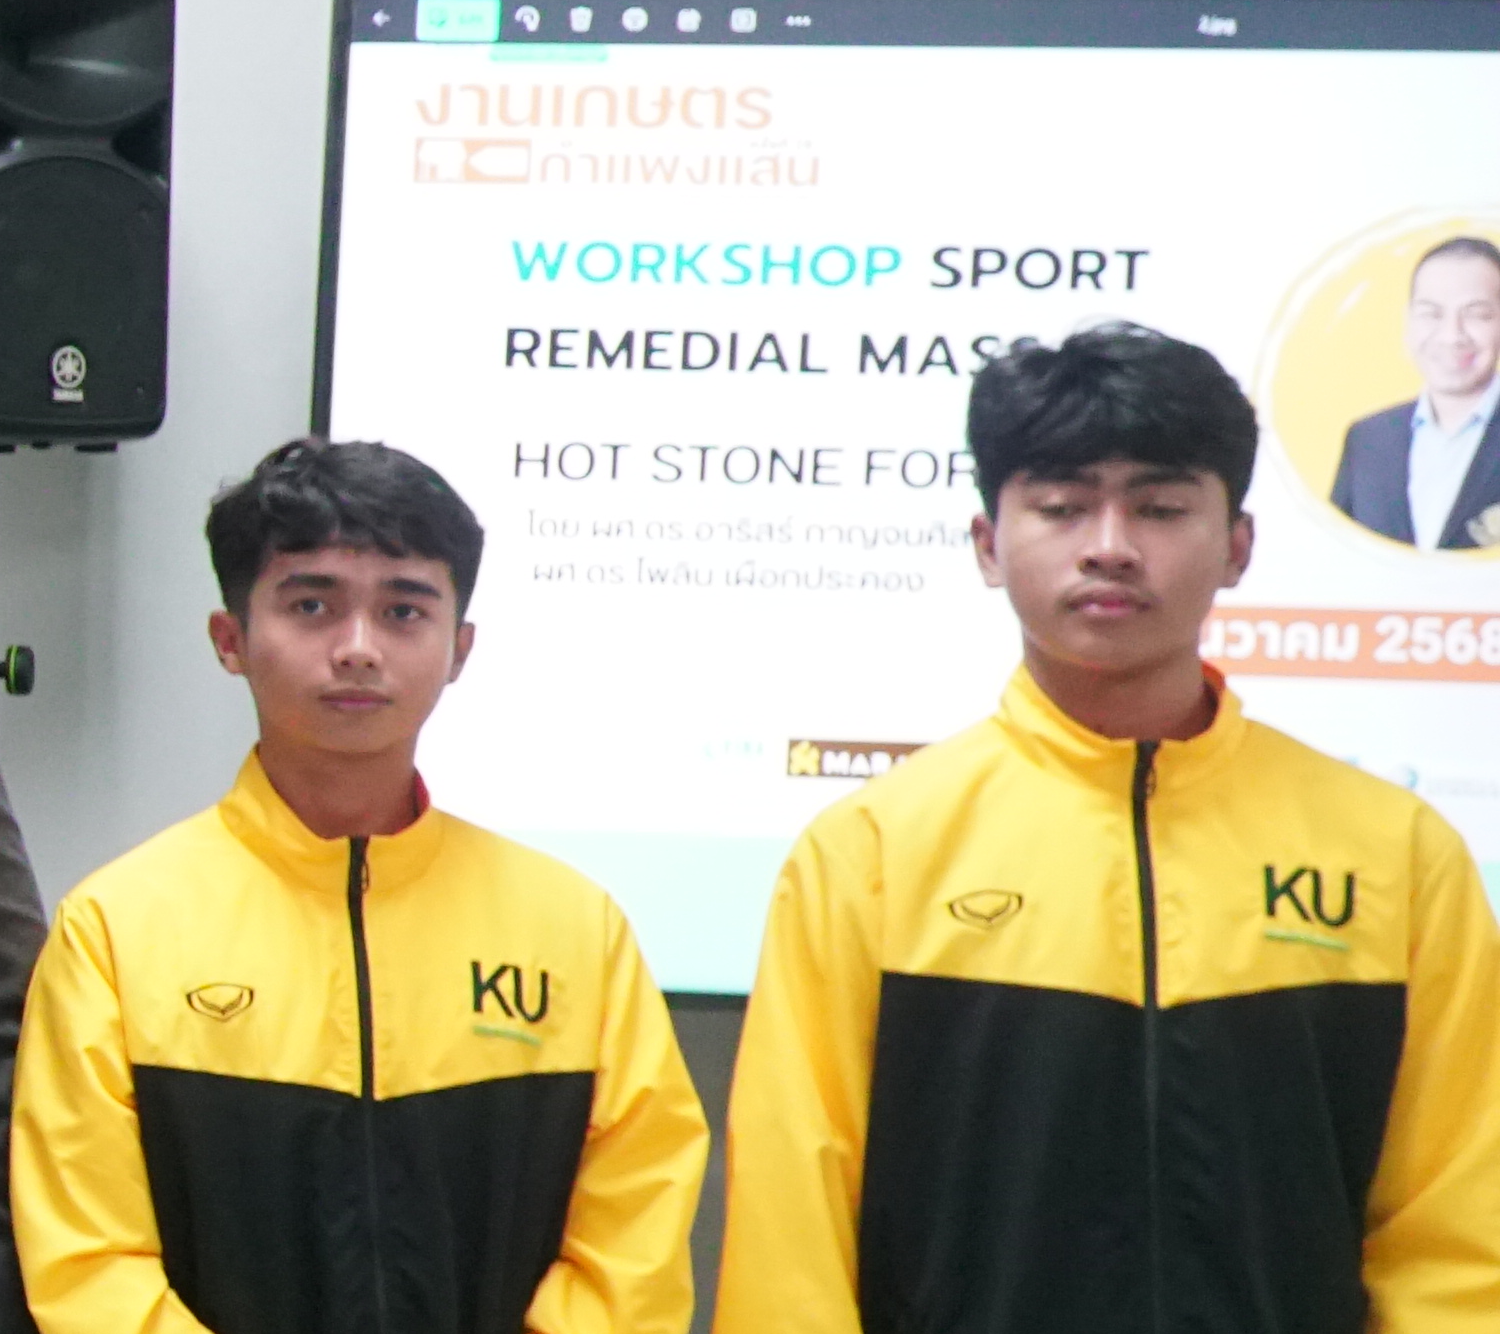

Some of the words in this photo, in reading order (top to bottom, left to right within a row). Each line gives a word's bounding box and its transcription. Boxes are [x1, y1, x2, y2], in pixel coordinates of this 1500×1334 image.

[416, 83, 773, 130] งานเกษตร
[511, 240, 903, 288] WORKSHOP
[930, 247, 1151, 291] SPORT
[504, 327, 828, 375] REMEDIAL
[512, 442, 631, 480] HOT
[651, 444, 843, 486] STONE
[1373, 616, 1500, 666] 2568
[1263, 864, 1355, 928] KU
[471, 960, 550, 1024] KU
